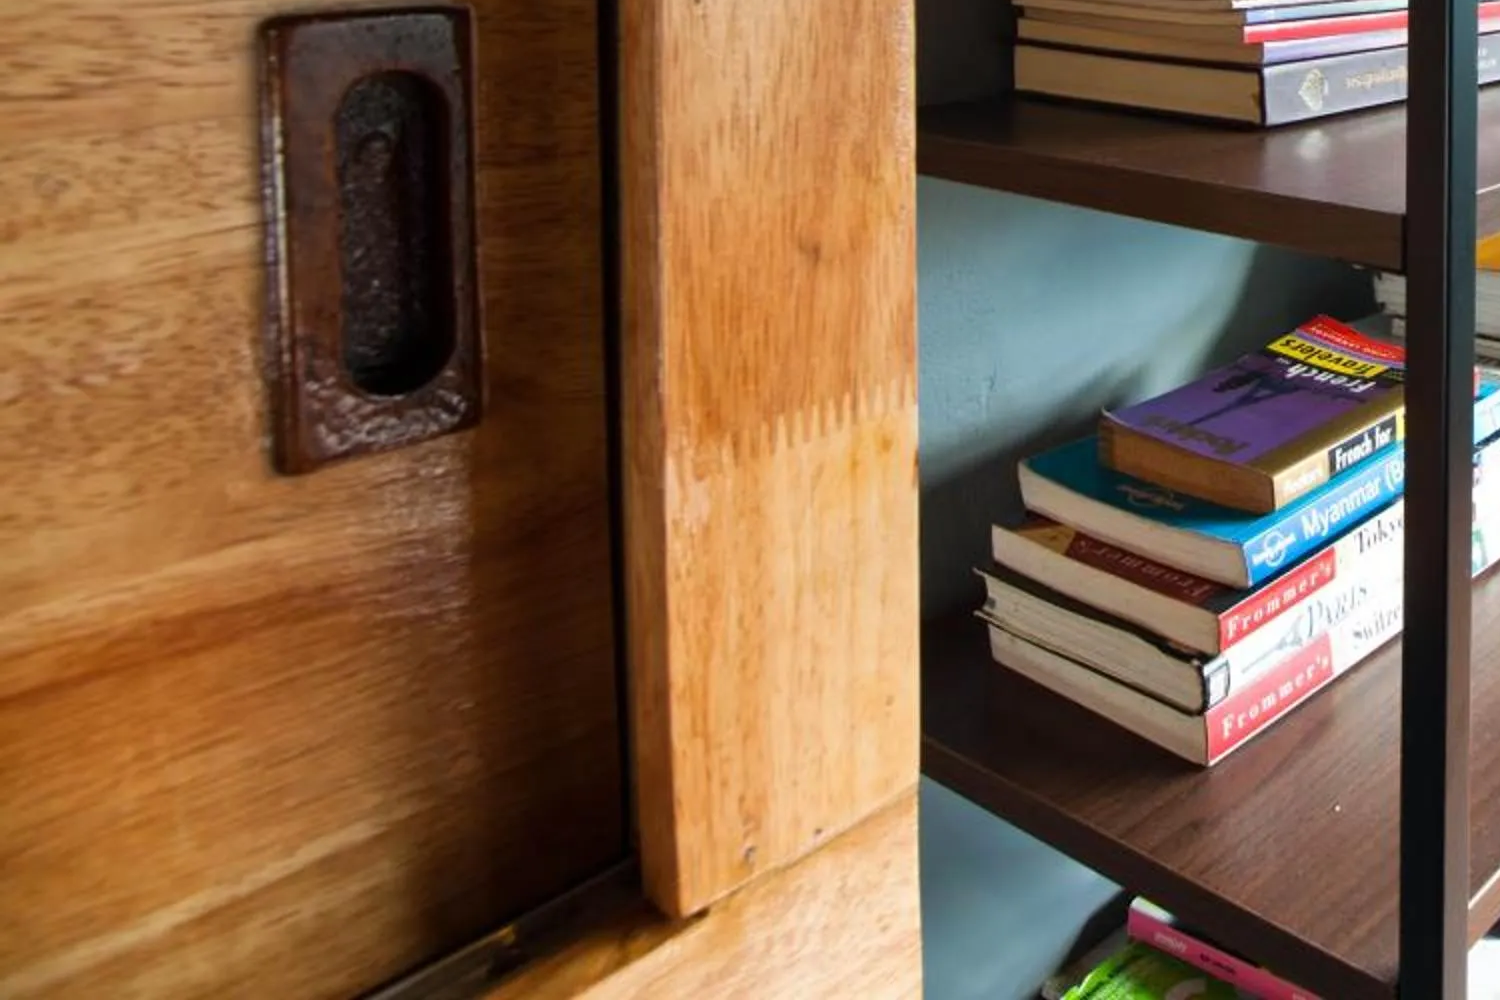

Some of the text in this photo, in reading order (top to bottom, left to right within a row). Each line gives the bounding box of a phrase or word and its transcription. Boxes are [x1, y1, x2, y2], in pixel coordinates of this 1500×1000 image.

[1280, 337, 1377, 376] Travelers
[1283, 360, 1377, 393] French
[1334, 431, 1376, 473] French
[1301, 477, 1381, 540] Myanmar
[1079, 540, 1214, 598] Frommer's
[1227, 562, 1332, 638] Frommer's
[1221, 604, 1402, 739] Frommer's Switze
